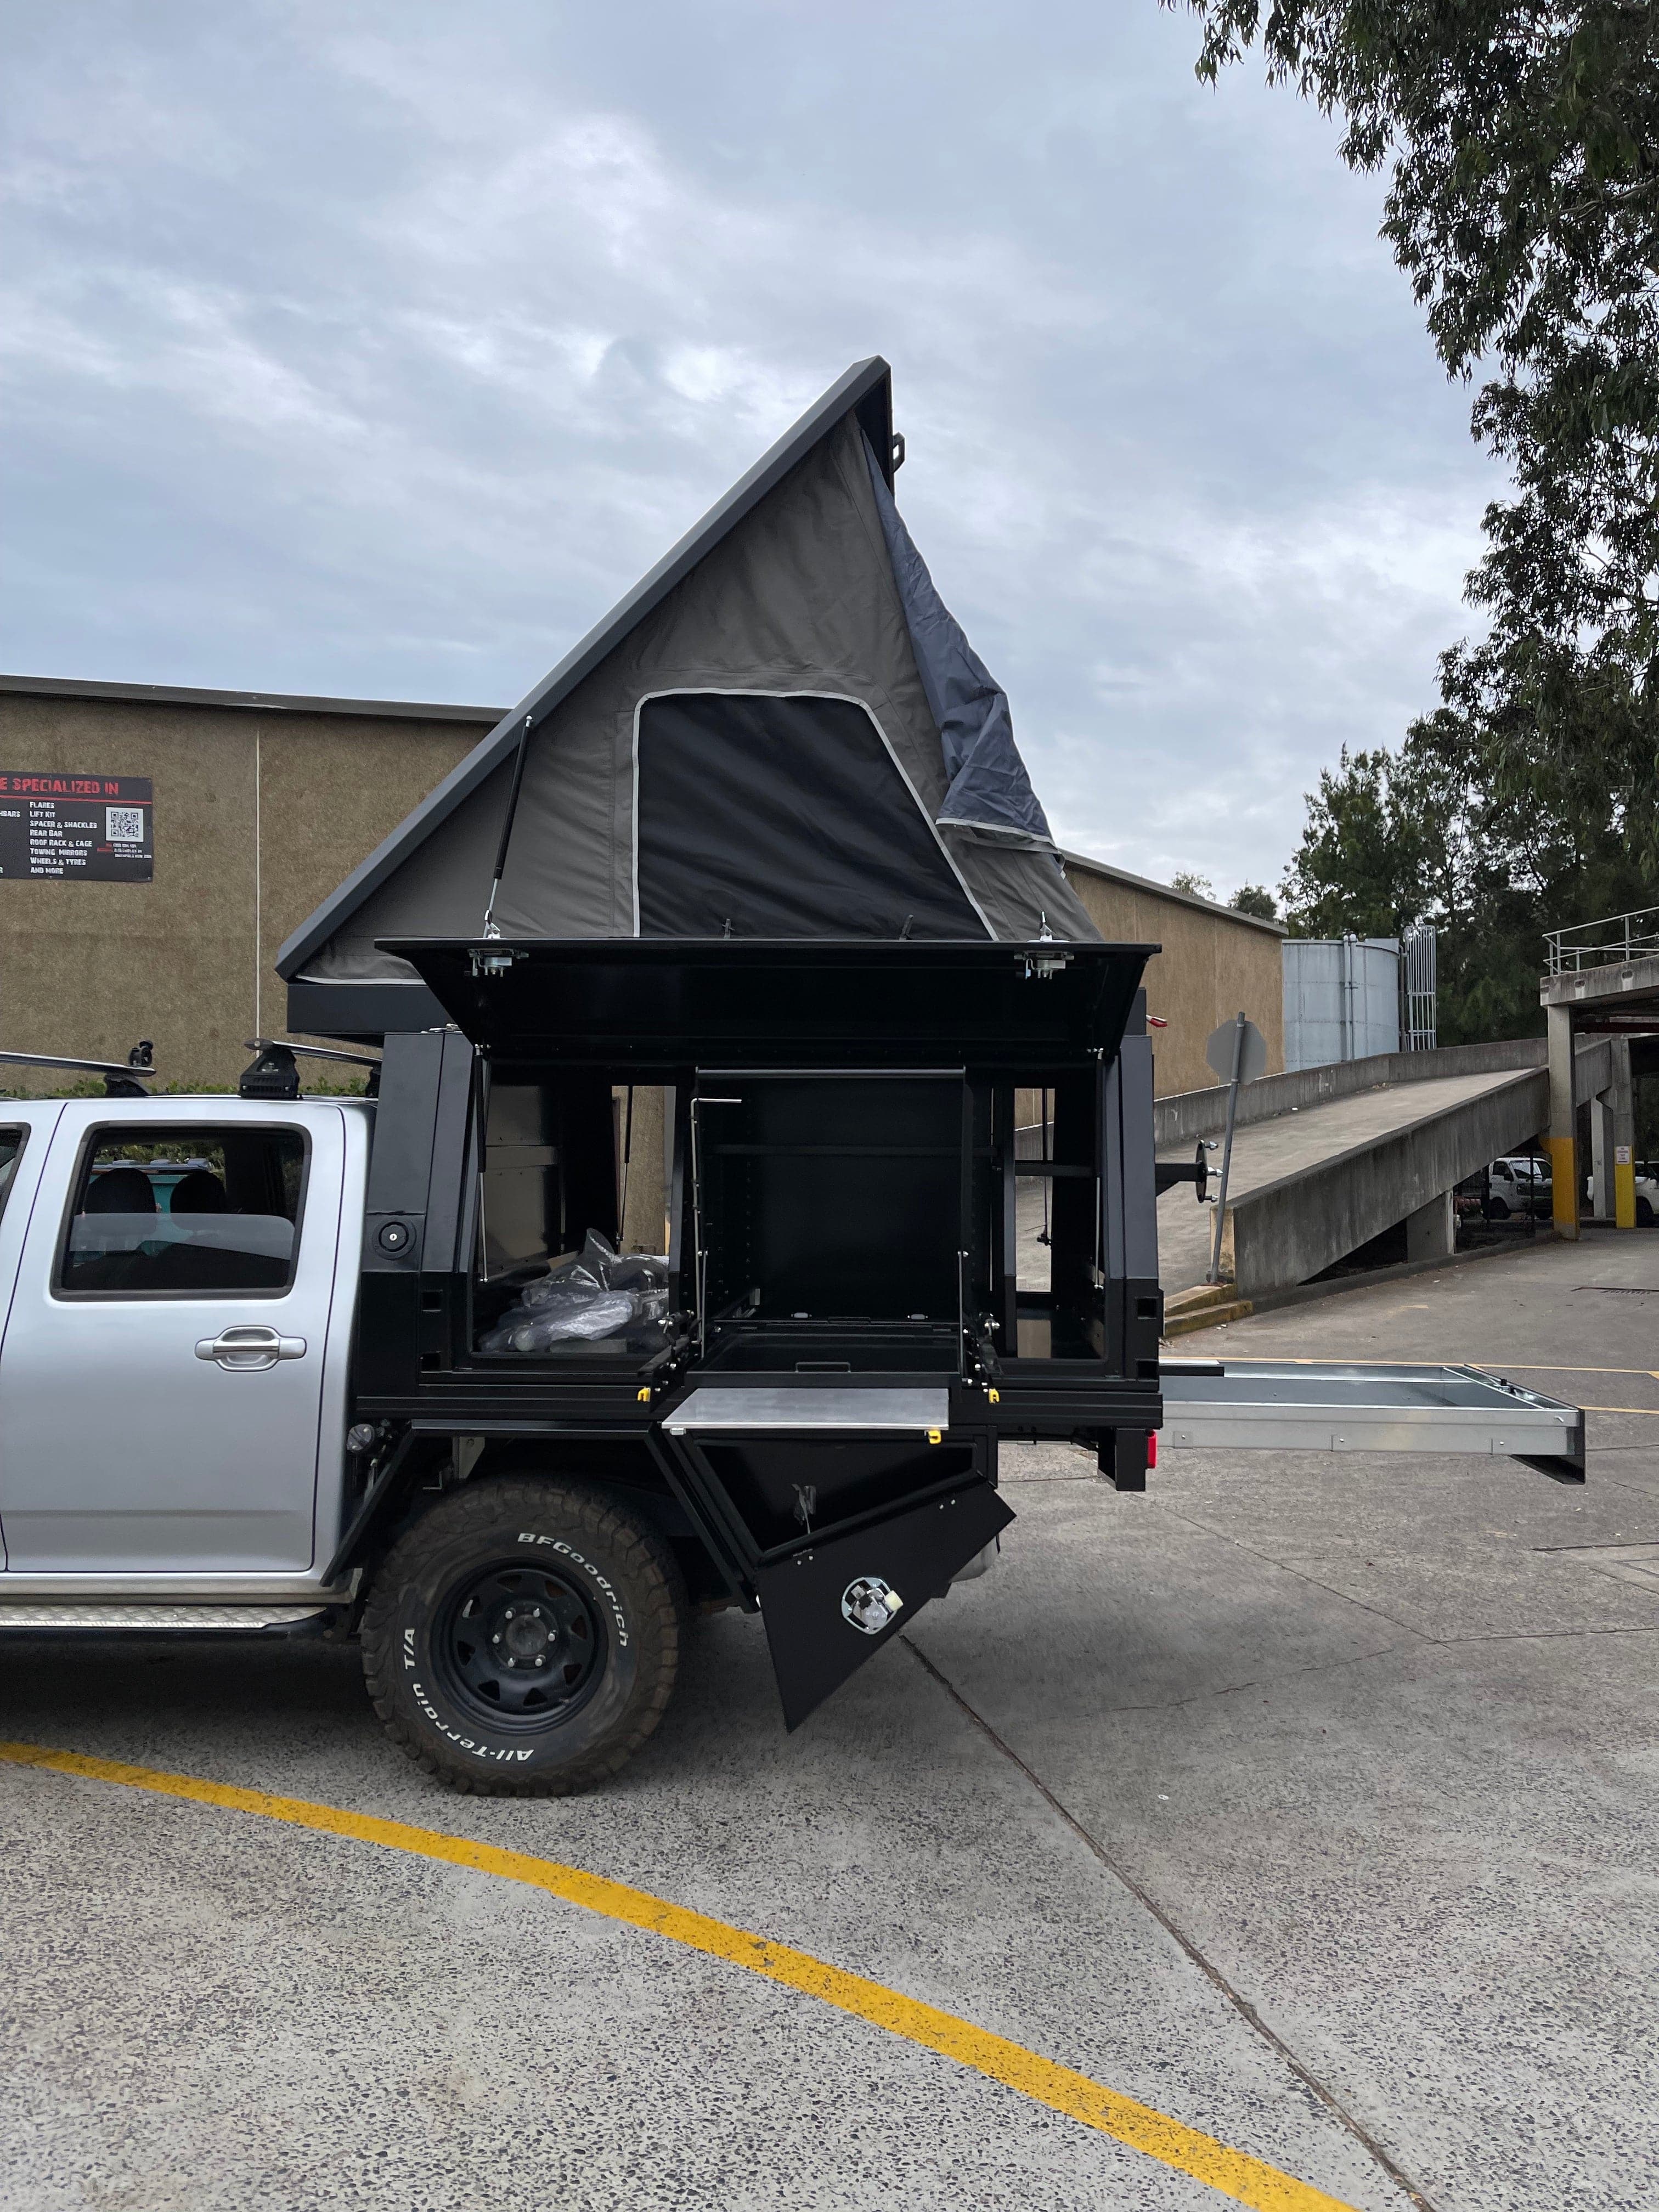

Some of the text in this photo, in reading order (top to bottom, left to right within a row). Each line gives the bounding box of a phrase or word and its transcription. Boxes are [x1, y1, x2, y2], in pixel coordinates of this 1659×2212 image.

[13, 778, 100, 794] SPECIALIZED
[105, 782, 119, 795] IN
[517, 1533, 629, 1647] BFGoodrich
[403, 1628, 534, 1761] All-Terrain T/A
